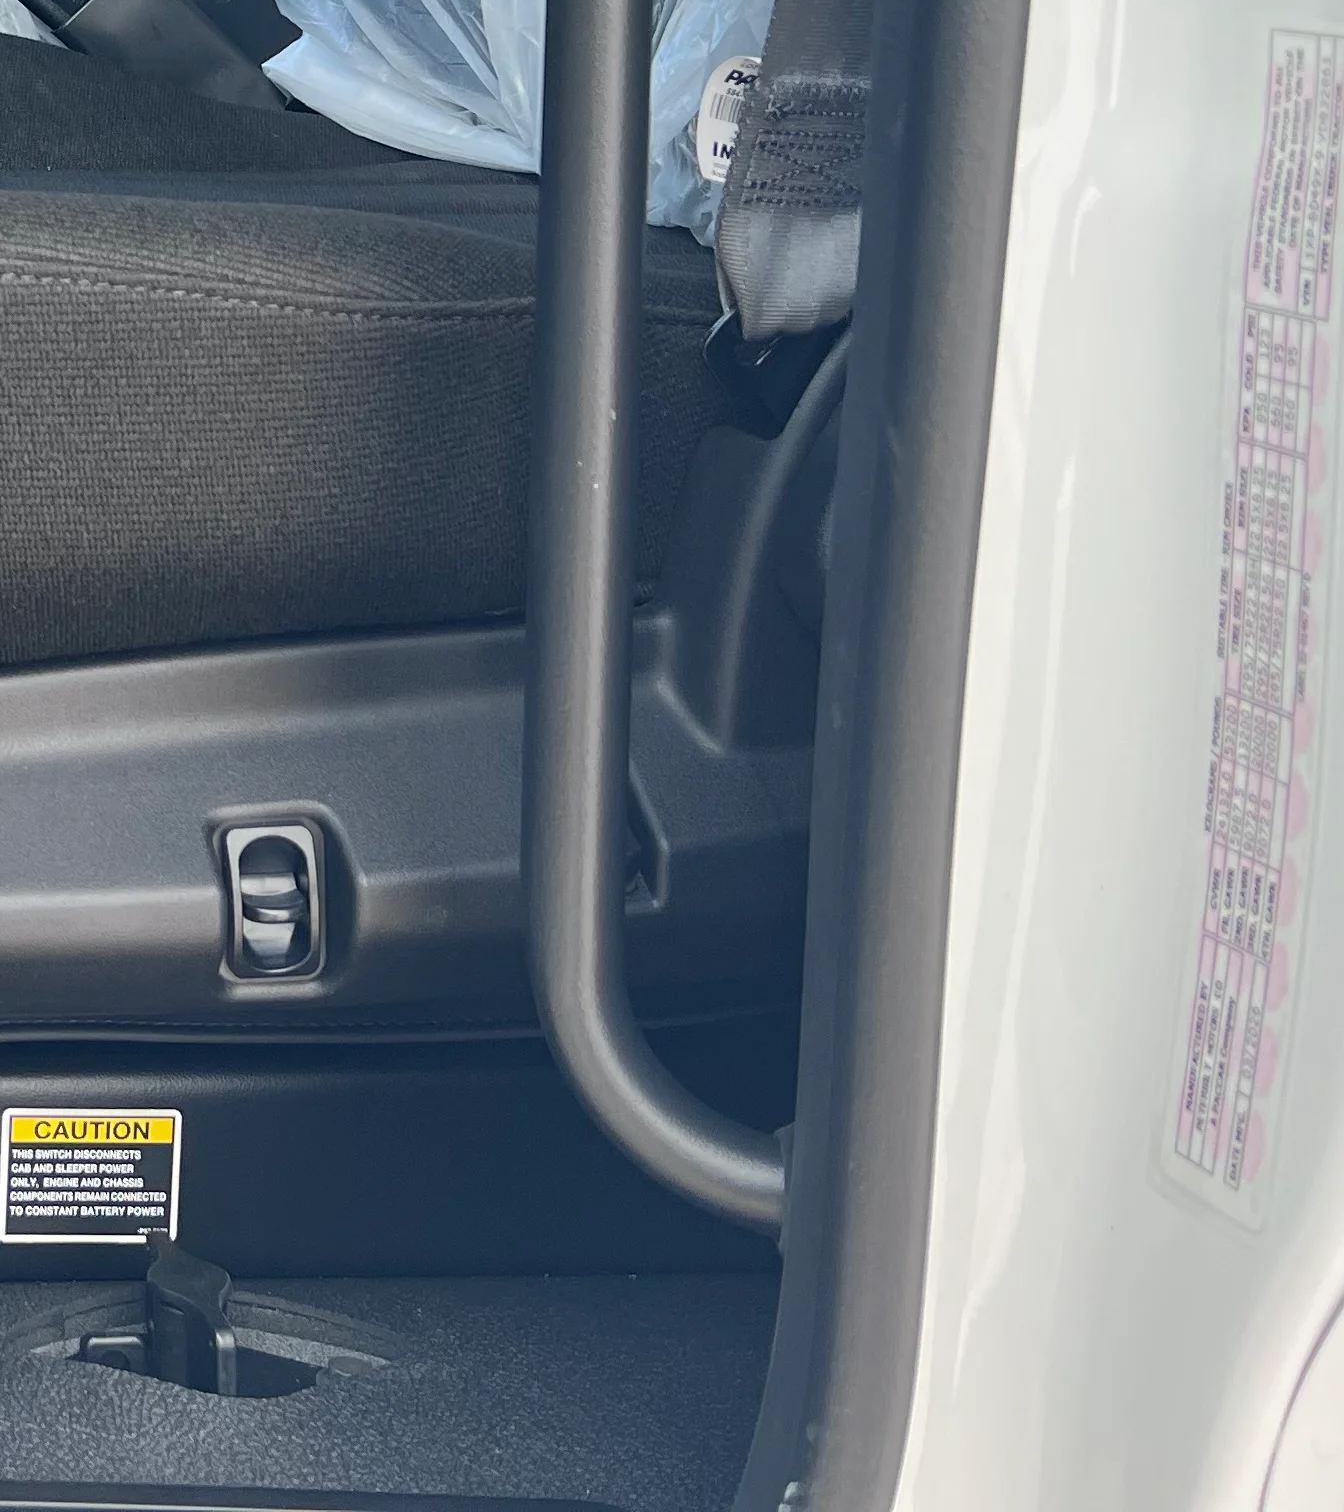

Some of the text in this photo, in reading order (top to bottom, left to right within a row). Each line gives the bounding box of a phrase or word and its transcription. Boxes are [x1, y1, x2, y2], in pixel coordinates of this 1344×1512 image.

[1301, 280, 1311, 306] VIN
[1245, 352, 1253, 391] COLD
[1199, 981, 1209, 1000] BY
[1211, 1061, 1225, 1114] PACCAR
[1219, 996, 1236, 1057] Company
[34, 1121, 150, 1140] CAUTION
[12, 1149, 141, 1160] THIS SWITCH DISCONNECTS
[1228, 1147, 1240, 1181] DATE
[11, 1164, 134, 1173] CAB AND SLEEPER POWER
[43, 1178, 79, 1187] ENGINE
[81, 1178, 101, 1187] AND
[102, 1178, 144, 1188] CHASSIS
[10, 1191, 166, 1202] COMPONENTS REMAIN CONNECTED
[9, 1206, 164, 1216] TO CONSTANT BATTERY POWER
